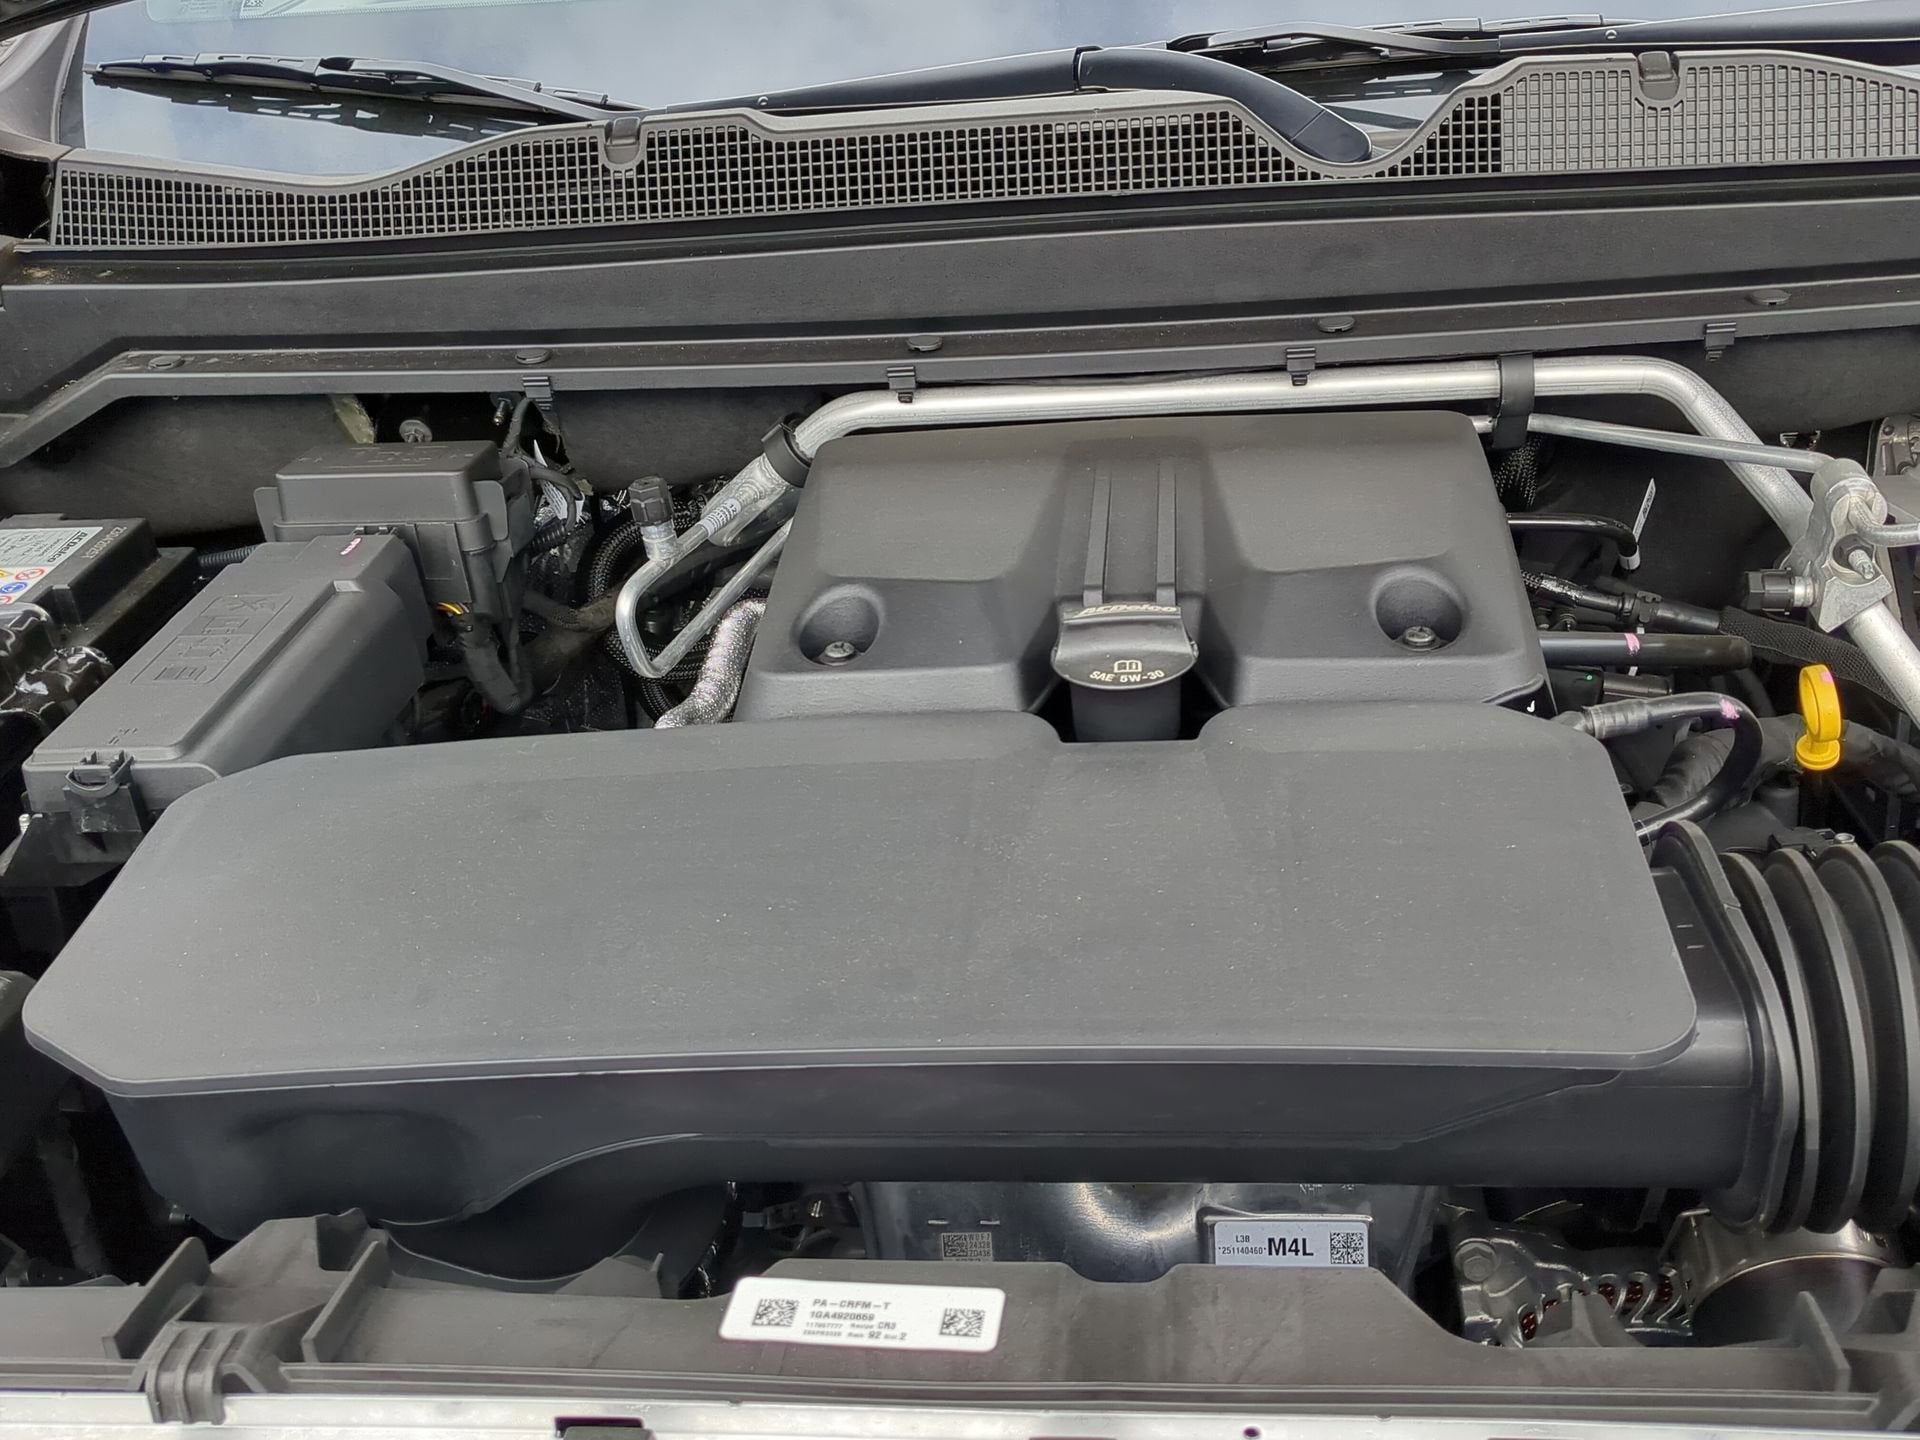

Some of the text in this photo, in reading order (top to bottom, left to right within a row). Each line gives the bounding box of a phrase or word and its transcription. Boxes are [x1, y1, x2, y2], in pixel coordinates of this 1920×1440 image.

[1073, 604, 1177, 618] ACDelco
[1089, 669, 1165, 683] SAE 5W-30
[1267, 1237, 1314, 1257] M4L
[867, 1330, 882, 1339] 92
